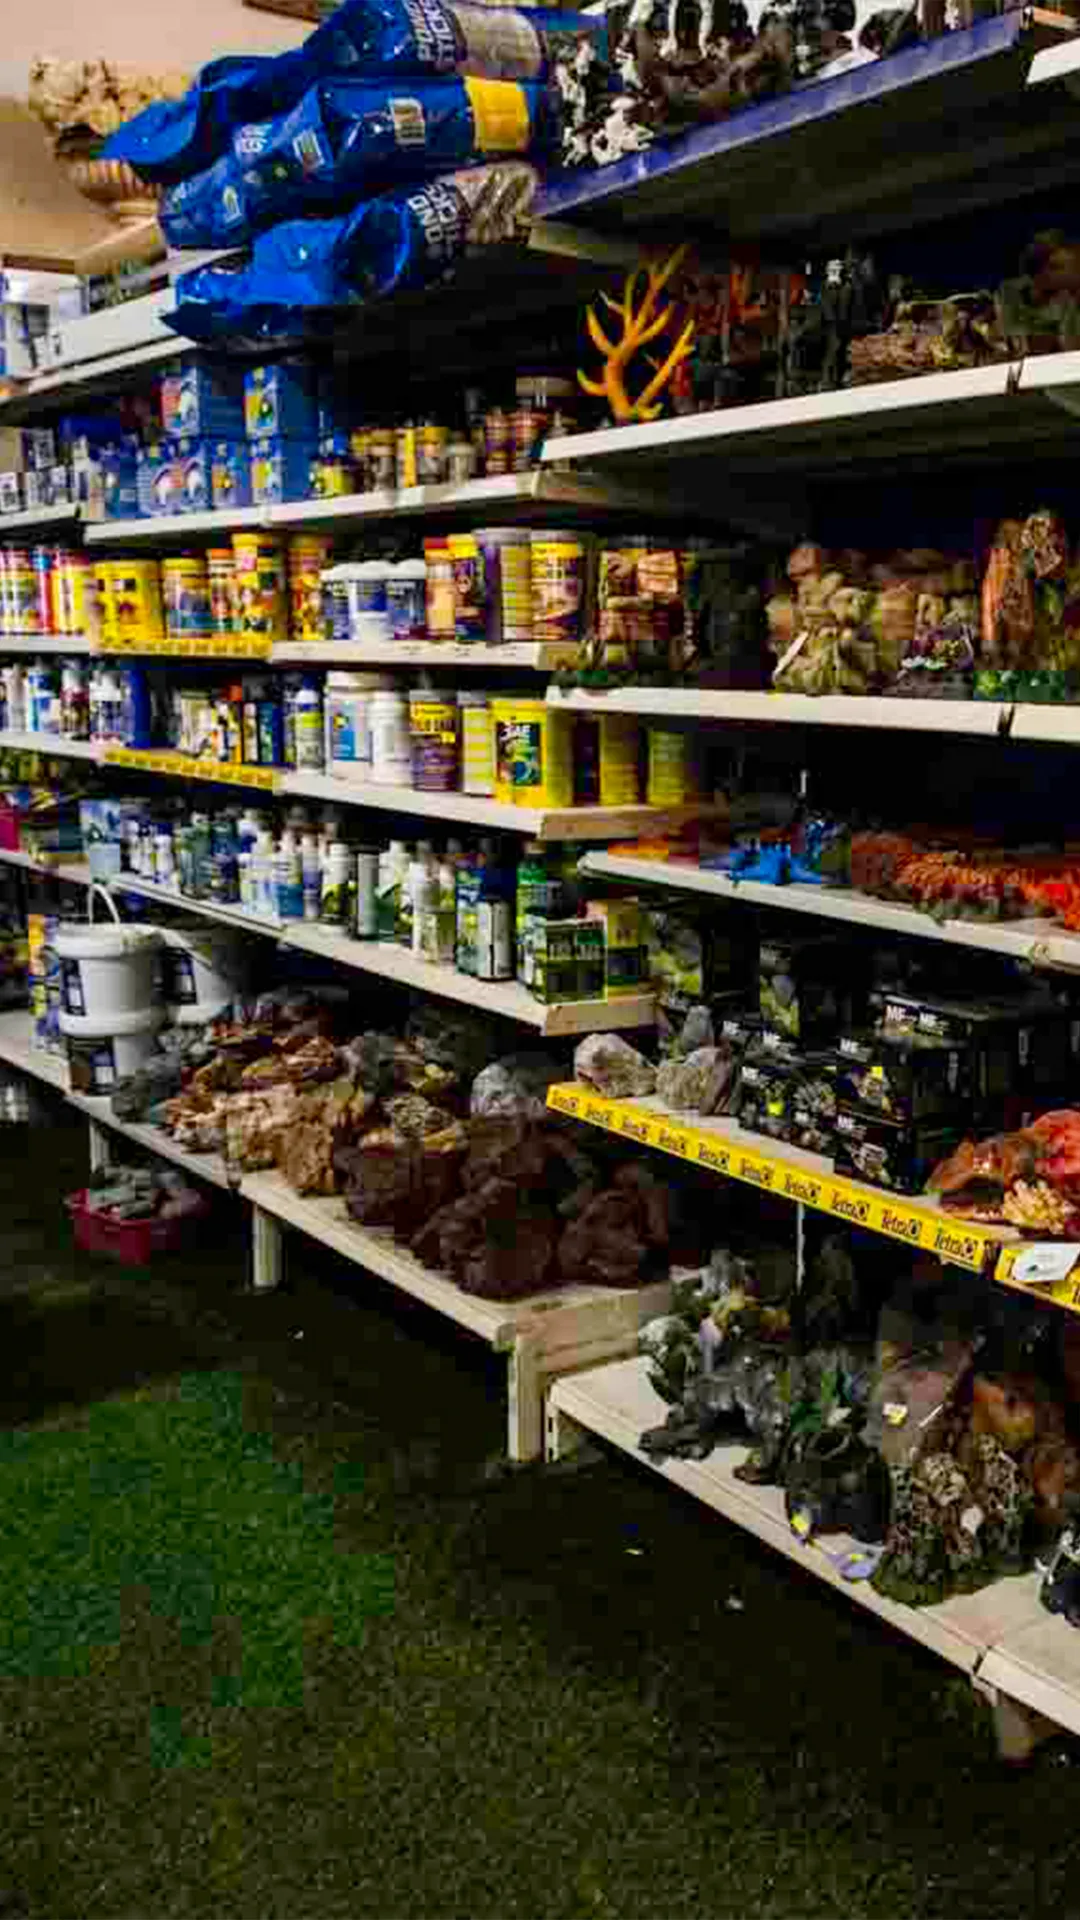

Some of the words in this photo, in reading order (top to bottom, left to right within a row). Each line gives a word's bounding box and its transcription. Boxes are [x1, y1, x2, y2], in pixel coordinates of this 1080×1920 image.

[832, 1190, 857, 1220] Tetra
[881, 1208, 907, 1237] Tetra
[934, 1230, 963, 1259] Tetra
